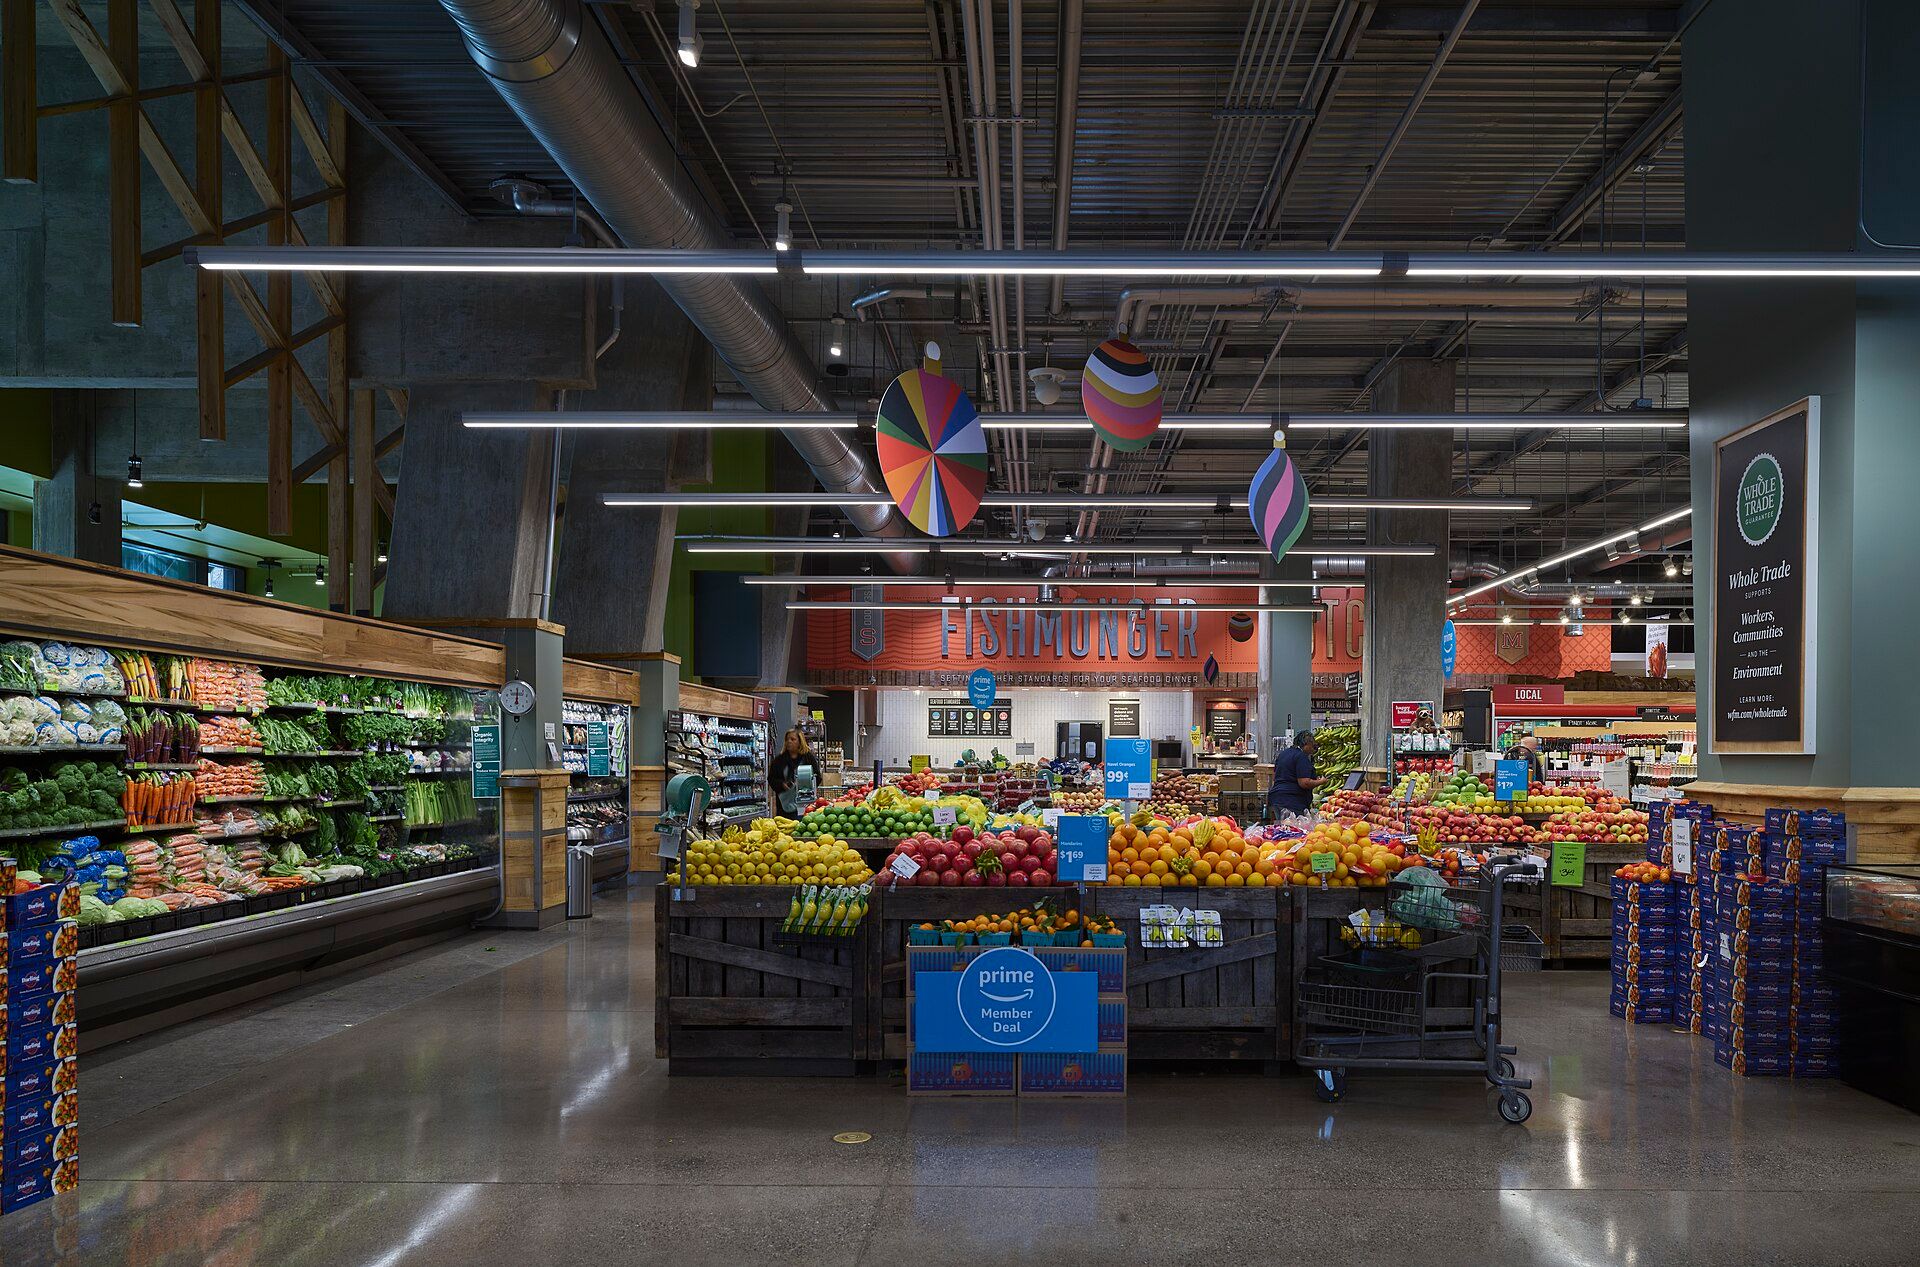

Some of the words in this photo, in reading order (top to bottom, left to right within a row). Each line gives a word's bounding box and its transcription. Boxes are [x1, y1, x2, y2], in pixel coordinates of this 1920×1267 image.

[1744, 477, 1776, 500] WHOLE
[1745, 494, 1775, 516] TRADE
[1729, 568, 1758, 589] Whole
[1761, 560, 1791, 582] Trade
[1745, 588, 1771, 599] SUPPORTS
[1741, 609, 1775, 625] Workers,
[941, 597, 1198, 657] FISHMONGER
[1733, 625, 1784, 643] Communities
[1747, 650, 1757, 658] AND
[1733, 663, 1783, 679] Environment
[974, 676, 990, 685] prime
[1073, 675, 1090, 683] FOR
[1094, 675, 1117, 683] YOUR
[1122, 675, 1161, 683] SEAFOOD
[1166, 675, 1198, 683] DINNER
[1515, 689, 1542, 700] LOCAL
[1728, 707, 1788, 721] wfm.com/wholetrade
[1107, 770, 1129, 783] 99¢
[1060, 850, 1083, 863] $169
[28, 901, 45, 910] Darling
[22, 940, 41, 948] Darling
[21, 975, 40, 983] Darling
[980, 966, 1034, 987] prime
[23, 1008, 41, 1017] Darling
[981, 1008, 1033, 1019] Member
[993, 1021, 1021, 1033] Deal
[23, 1041, 41, 1051] Darling
[19, 1076, 39, 1087] Darling
[20, 1110, 39, 1122] Darling
[20, 1145, 39, 1157] Darling
[17, 1179, 37, 1191] Darling
